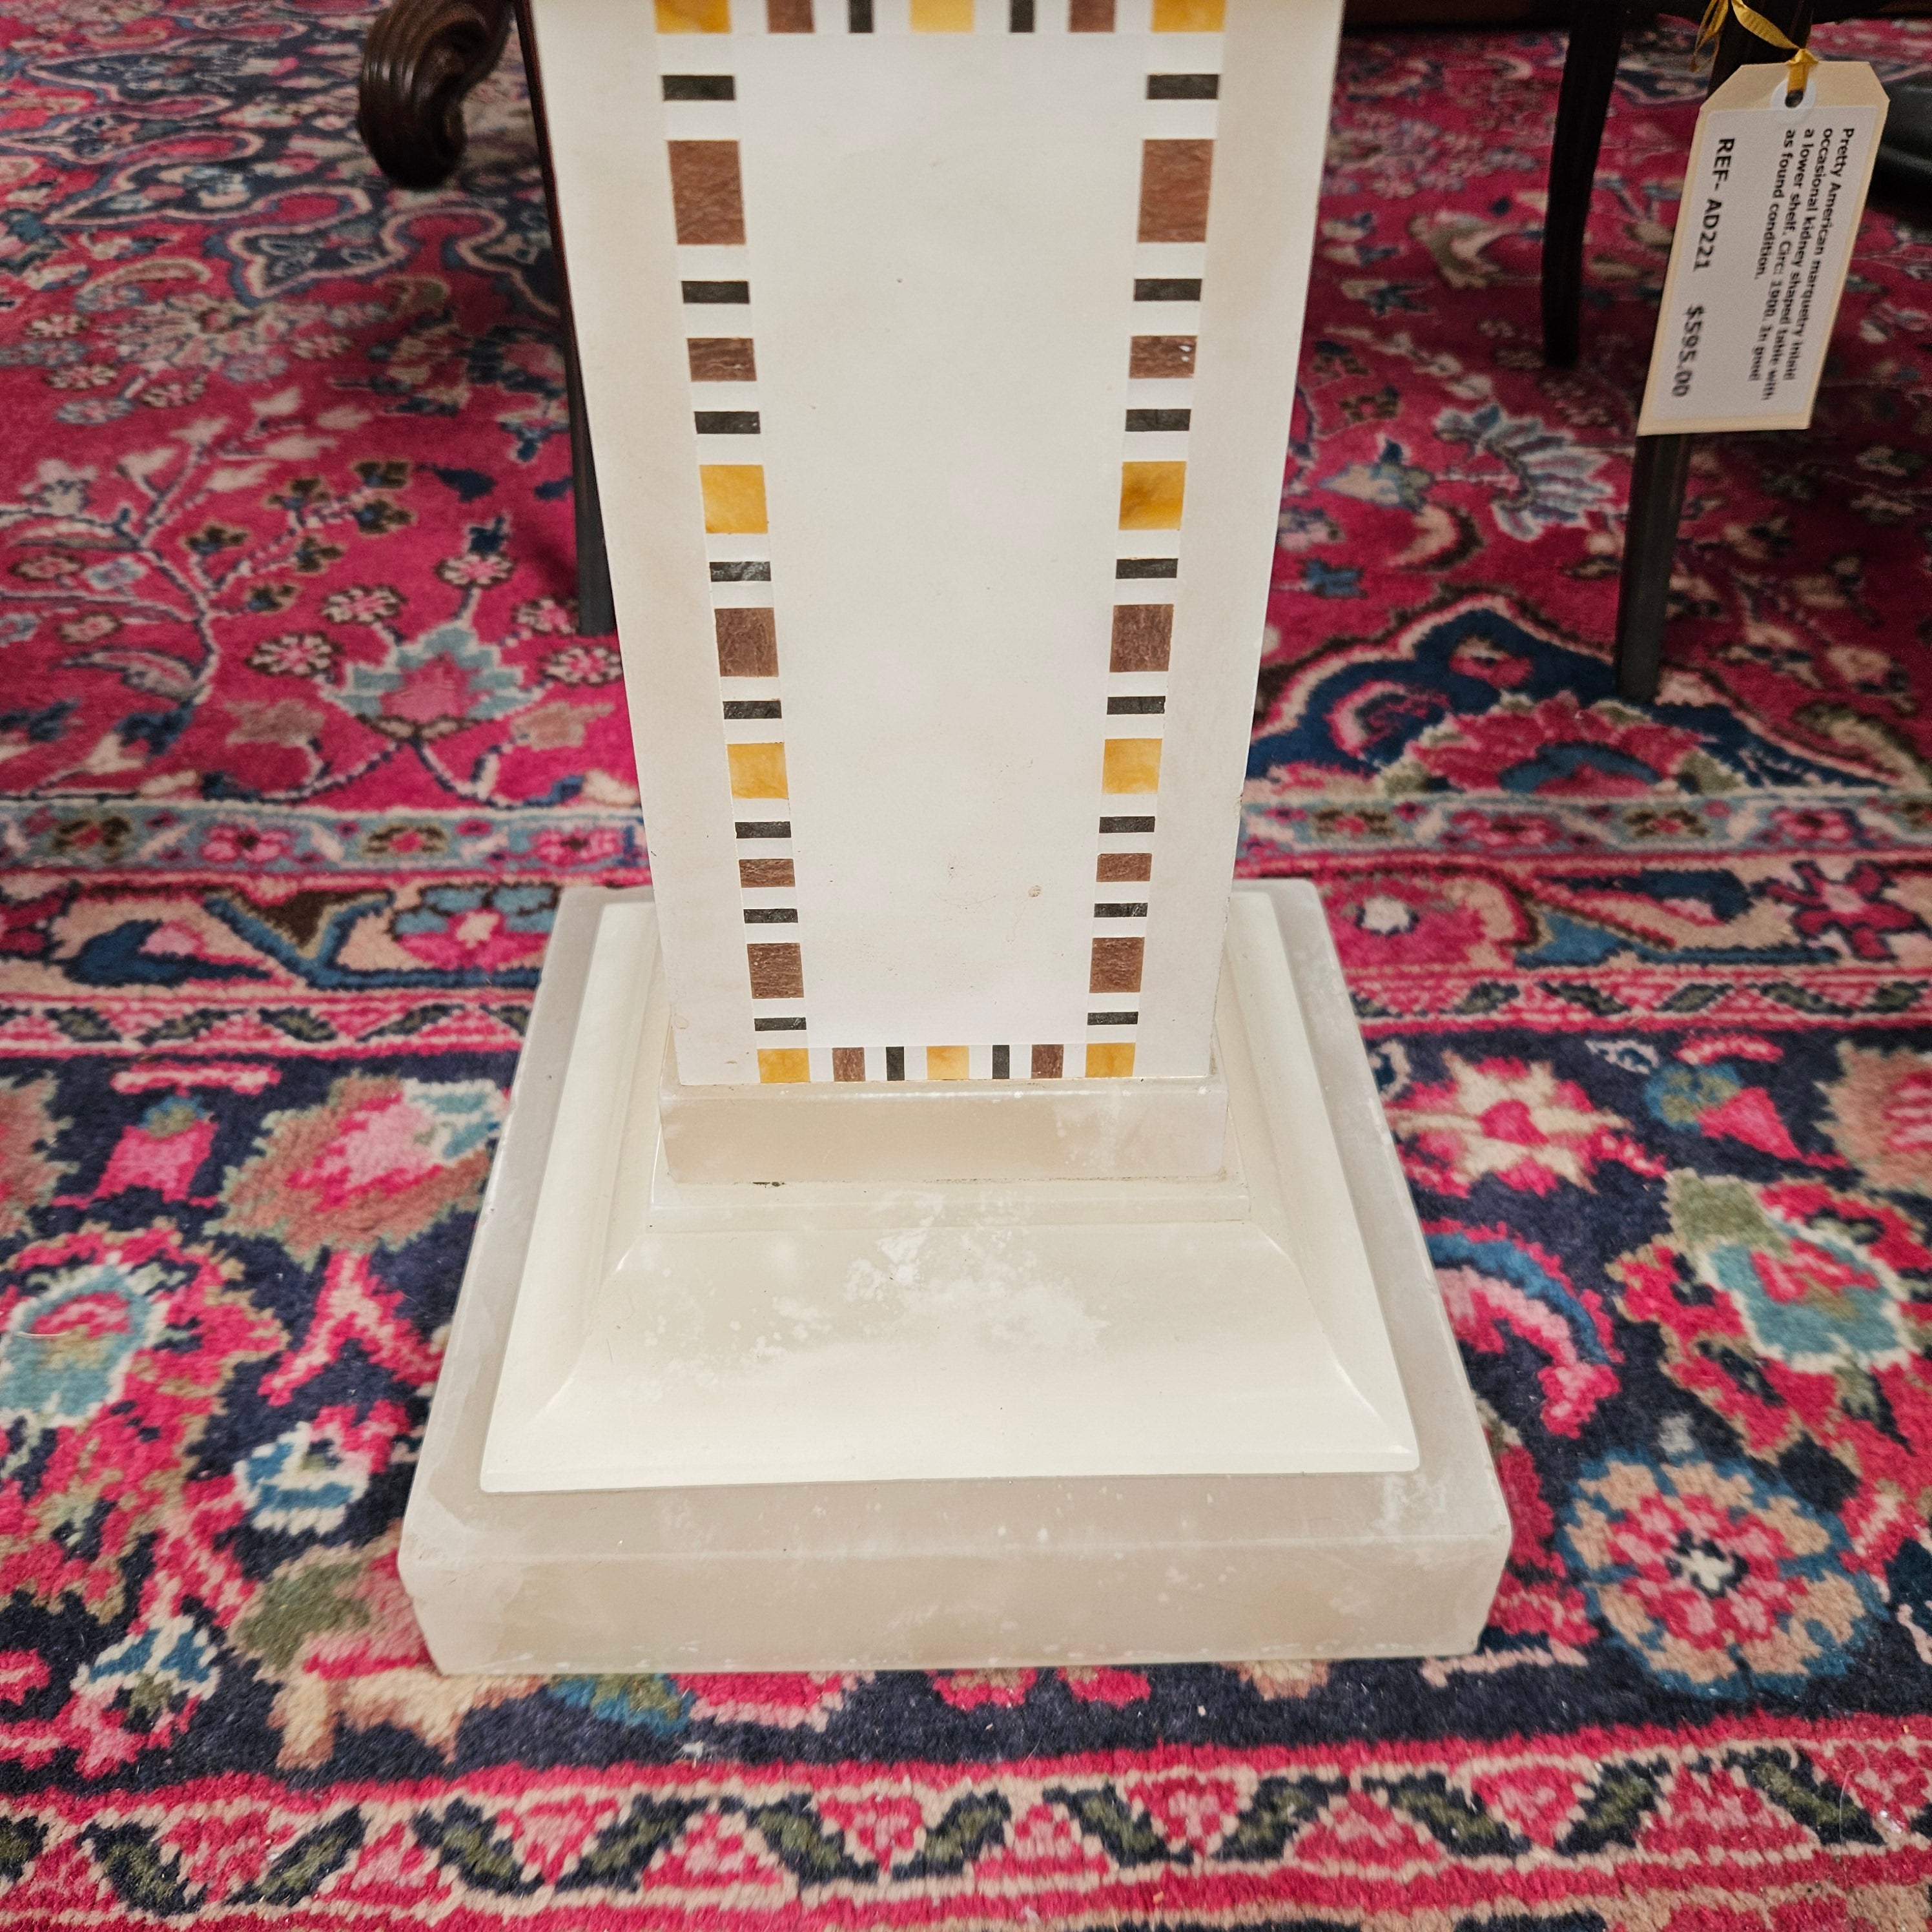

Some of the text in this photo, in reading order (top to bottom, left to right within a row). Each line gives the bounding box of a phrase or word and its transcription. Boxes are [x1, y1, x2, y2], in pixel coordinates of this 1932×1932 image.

[1804, 128, 1814, 138] a
[1830, 128, 1855, 177] Pretty
[1793, 143, 1814, 189] lower
[1754, 128, 1796, 280] as found condition.
[1782, 192, 1802, 236] shelf.
[1813, 181, 1841, 255] American
[1671, 138, 1736, 398] REF- AD221 $595.00
[1761, 128, 1833, 400] occasional kidney shaped table with
[1791, 259, 1821, 337] marquetry
[1758, 325, 1773, 342] In
